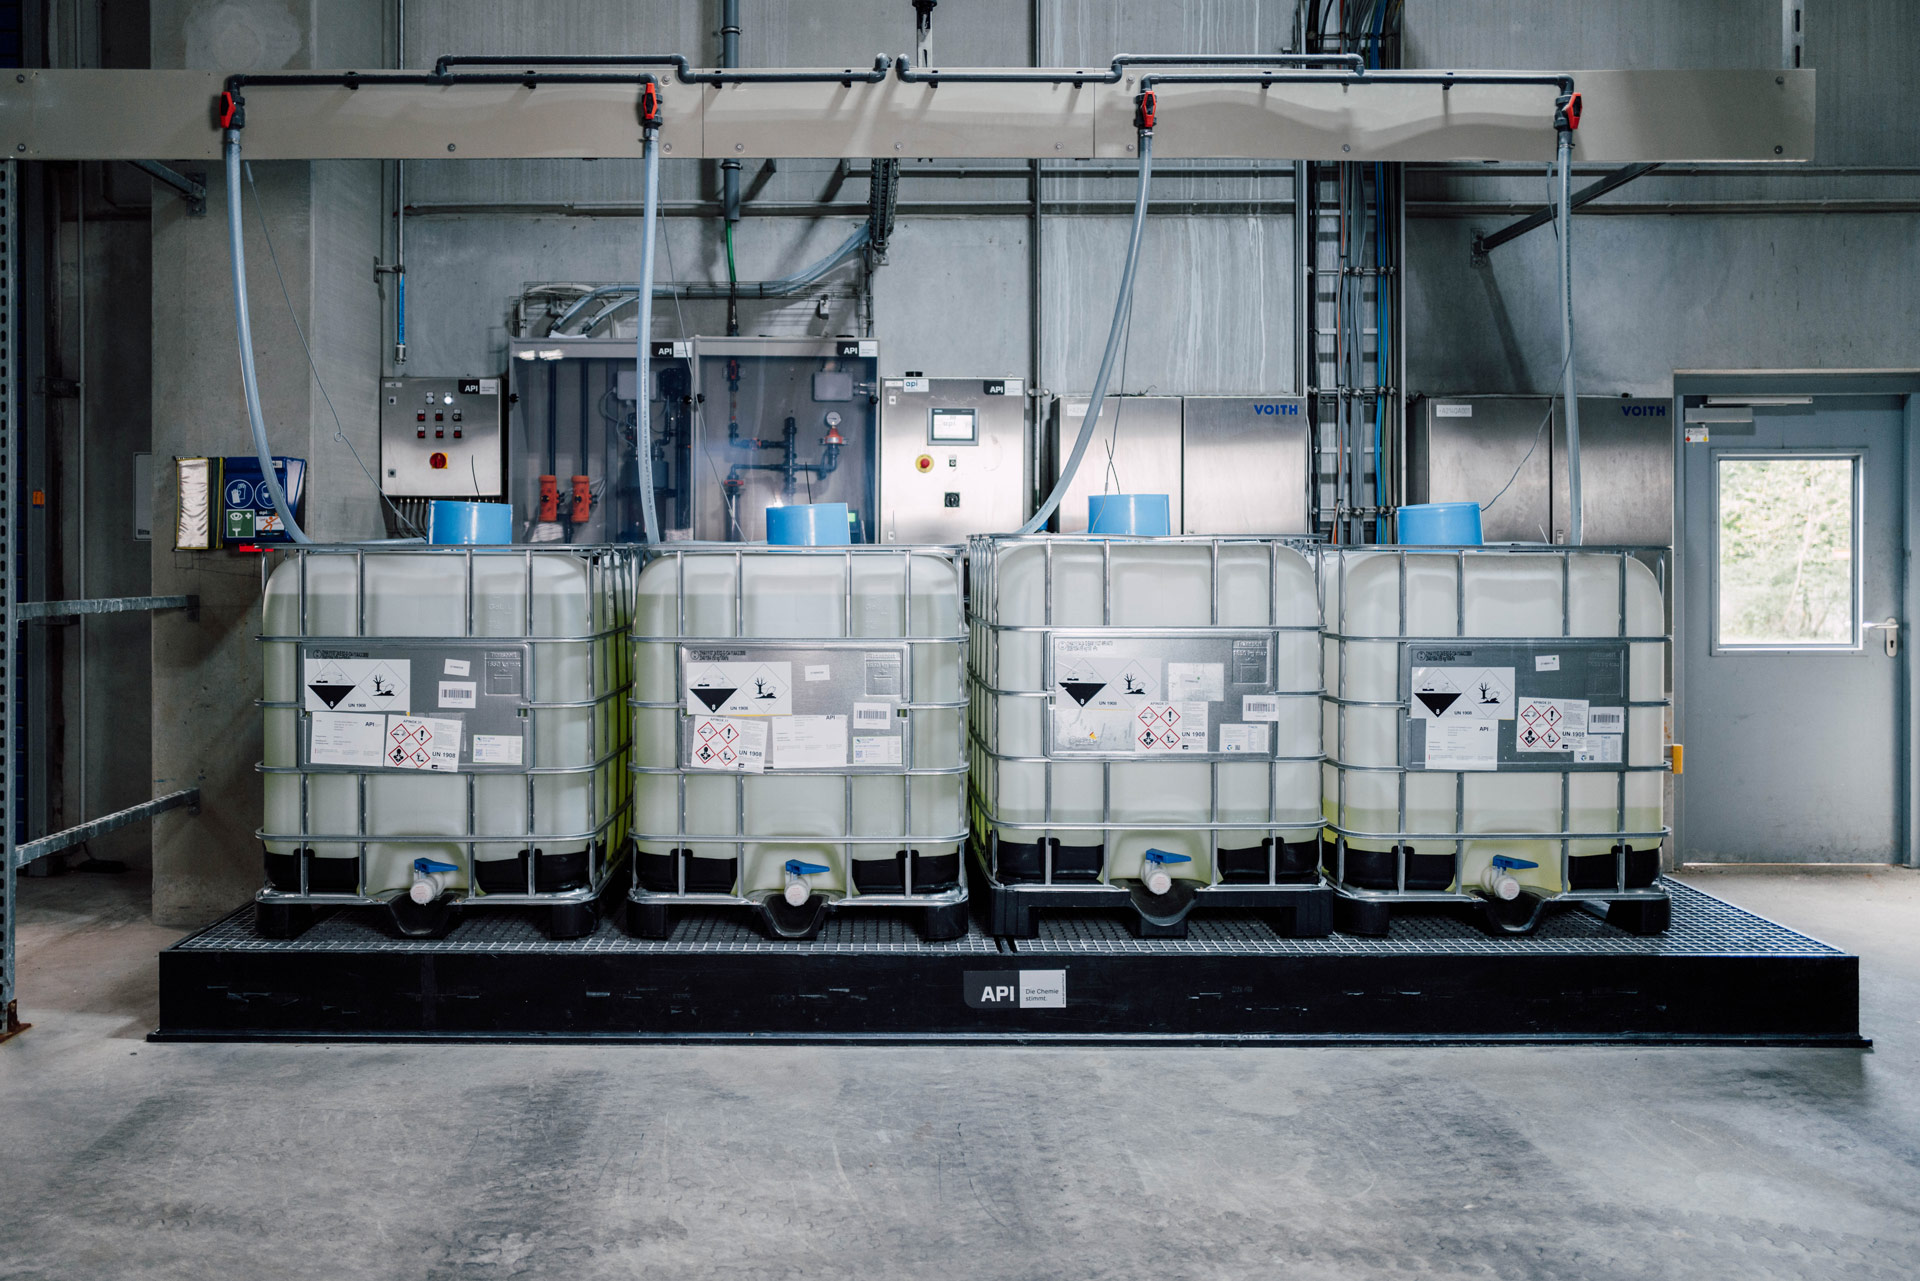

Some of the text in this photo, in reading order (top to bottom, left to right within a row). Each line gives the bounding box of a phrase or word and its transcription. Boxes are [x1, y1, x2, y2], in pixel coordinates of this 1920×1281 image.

[658, 347, 672, 355] API
[843, 347, 858, 355] API
[905, 380, 918, 388] api
[1253, 404, 1298, 416] VOITH
[1621, 405, 1666, 416] VOITH
[711, 703, 716, 711] 8
[981, 986, 1015, 1002] API
